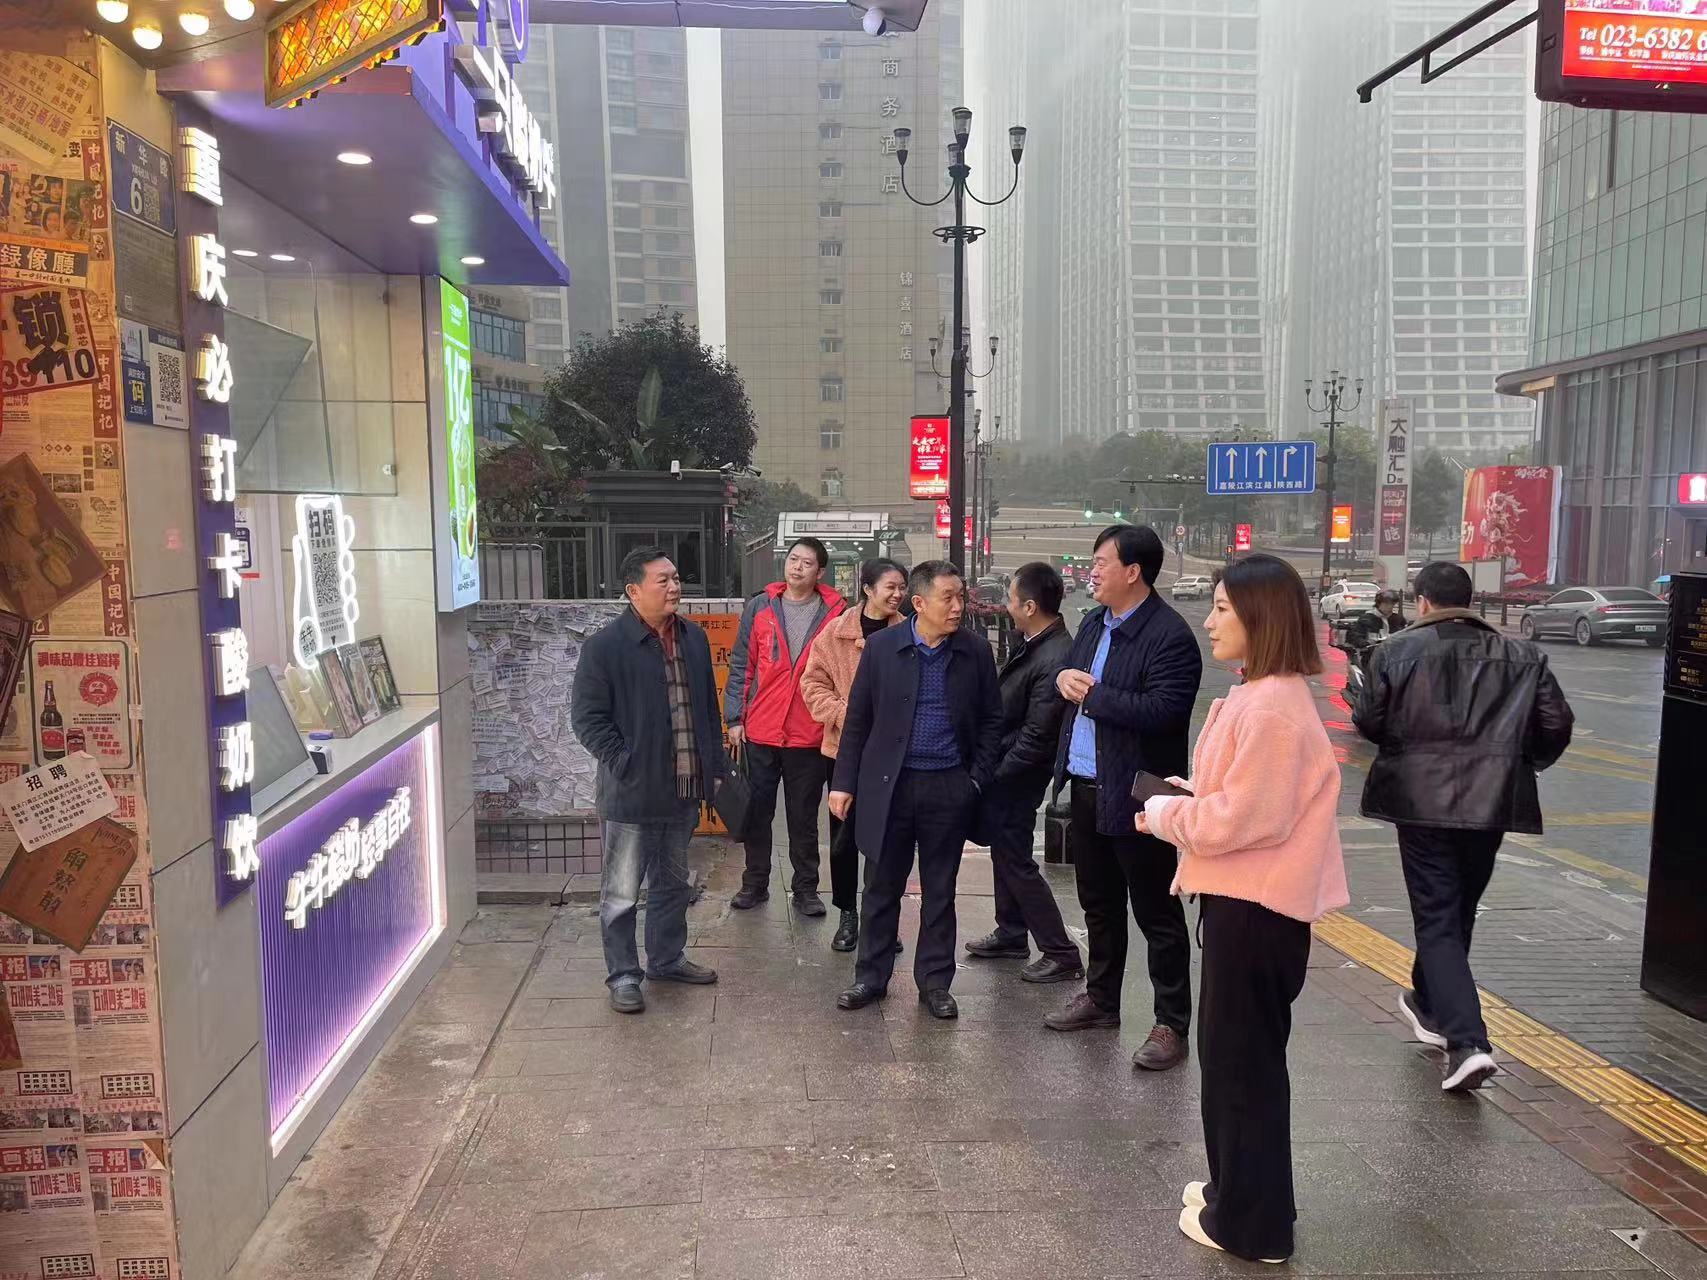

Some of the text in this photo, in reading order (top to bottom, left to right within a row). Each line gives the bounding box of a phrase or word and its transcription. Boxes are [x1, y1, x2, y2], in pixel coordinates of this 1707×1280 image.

[1600, 24, 1694, 50] 023-6382
[881, 28, 900, 193] 商务酒店
[131, 177, 143, 215] 6
[1219, 480, 1303, 490] 嘉陵江滨江路 陕西路
[308, 510, 335, 539] 扫码
[107, 563, 127, 636] 中国记忆
[25, 764, 68, 791] 招聘
[9, 984, 64, 1008] 五讲四美三热爱
[92, 987, 147, 1012] 五讲四美三热爱
[29, 1171, 82, 1196] 五讲四美三热爱
[110, 1176, 162, 1198] 五讲四美三热爱
